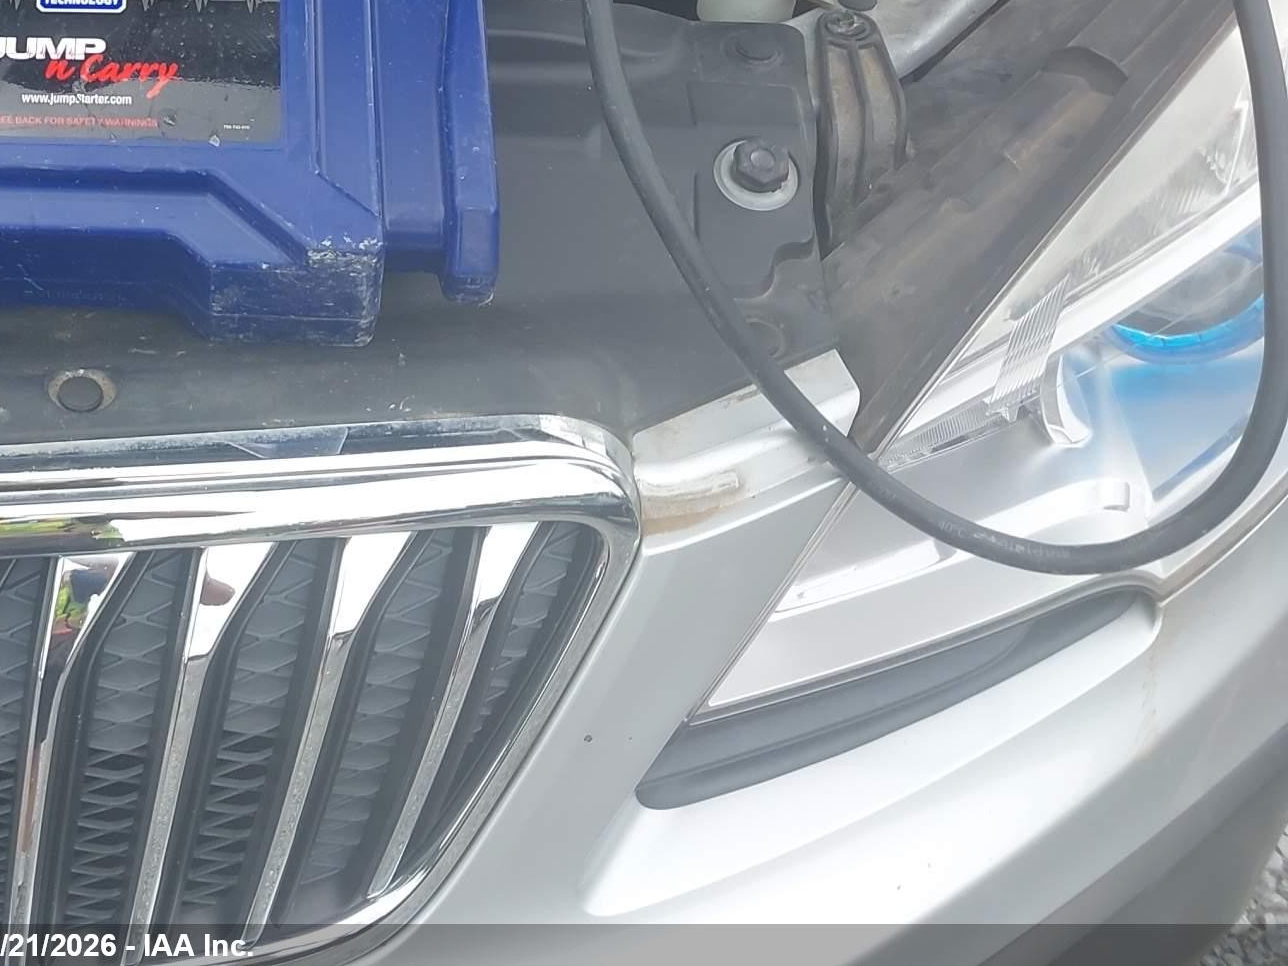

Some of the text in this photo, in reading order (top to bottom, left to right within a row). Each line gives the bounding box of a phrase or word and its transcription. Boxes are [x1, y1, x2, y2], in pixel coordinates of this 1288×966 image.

[44, 53, 179, 99] n Carry
[15, 115, 42, 125] BACK
[44, 116, 65, 125] FOR
[66, 116, 103, 126] SAFETY
[105, 117, 158, 128] WARNINGS
